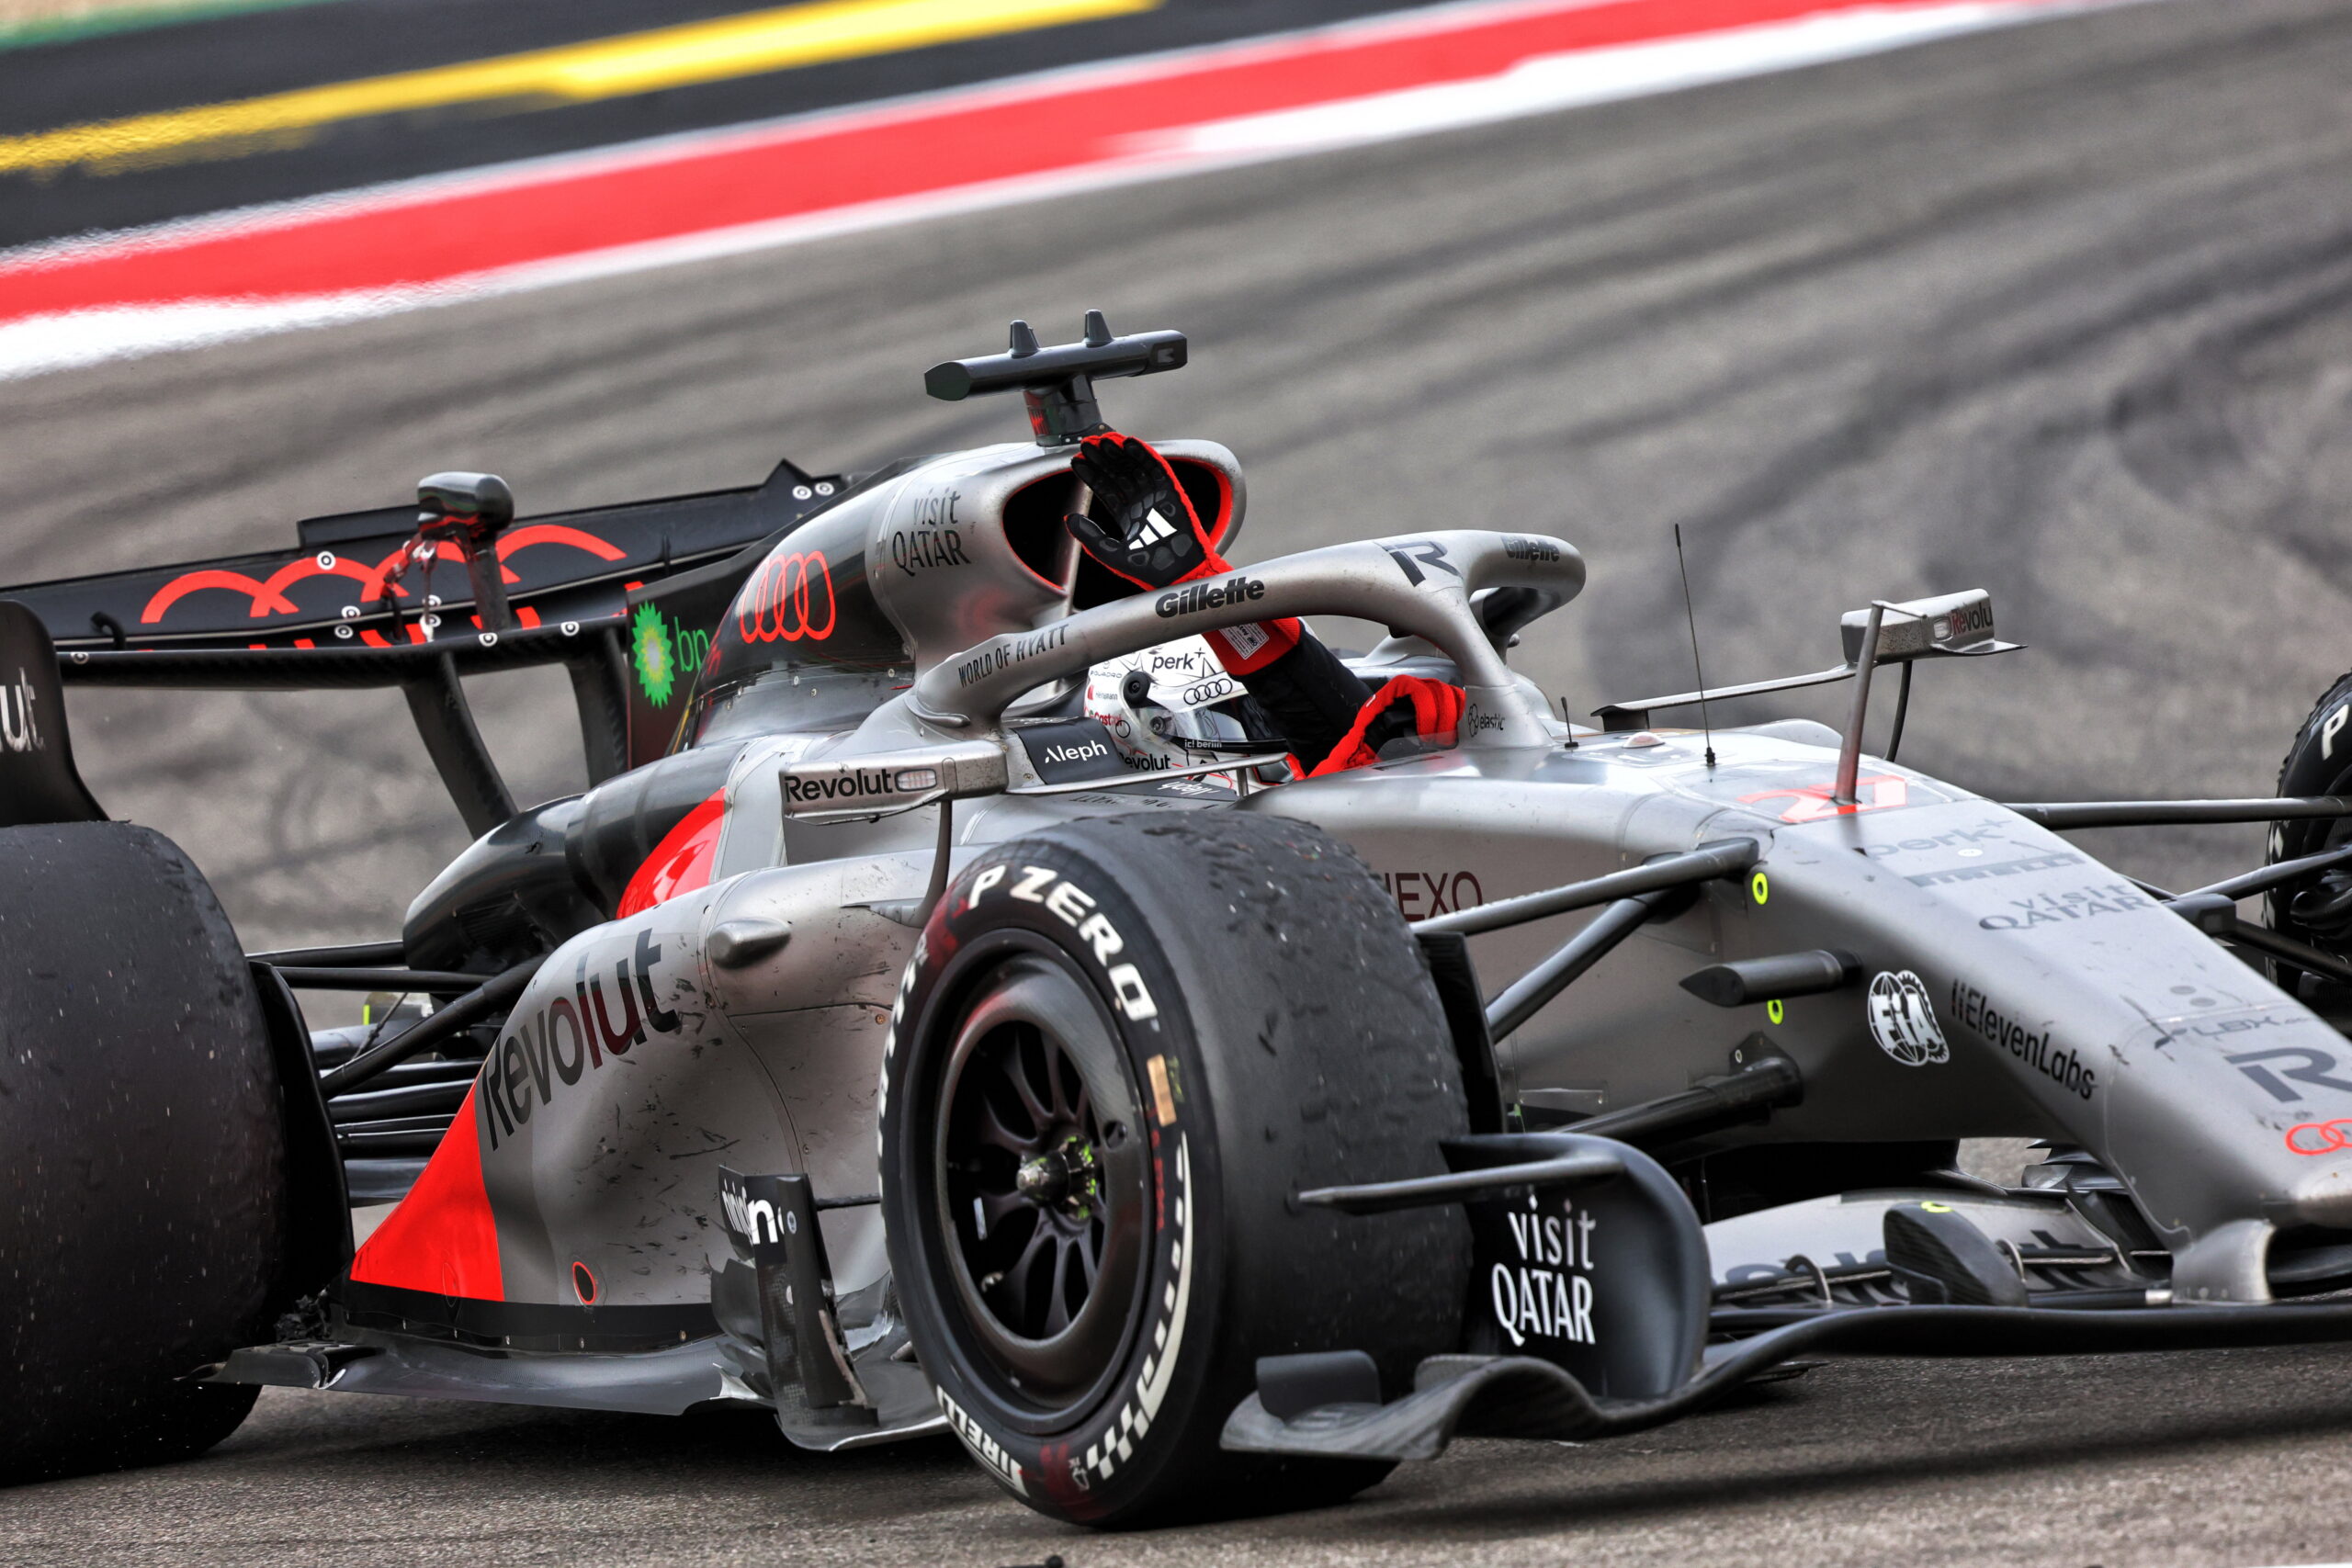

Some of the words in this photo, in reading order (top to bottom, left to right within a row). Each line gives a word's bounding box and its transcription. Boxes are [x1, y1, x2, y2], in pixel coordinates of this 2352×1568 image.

[913, 487, 961, 525] visit
[892, 530, 972, 577] QATAR
[1155, 577, 1265, 618] Gillette
[1951, 603, 1994, 636] Revolu
[958, 653, 992, 688] WORLD
[995, 644, 1012, 670] OF
[1016, 624, 1069, 661] HYATT
[0, 667, 45, 751] ut
[1480, 713, 1506, 730] elastic
[1046, 740, 1107, 763] Aleph
[2322, 705, 2349, 761] P
[1119, 753, 1170, 771] evolut
[784, 768, 893, 803] Revolut
[1979, 896, 2155, 931] QATAR
[2009, 884, 2130, 909] visit
[967, 864, 1006, 910] P
[1010, 864, 1158, 1021] ZERO
[1508, 1194, 1596, 1270] visit
[1491, 1262, 1596, 1347] QATAR
